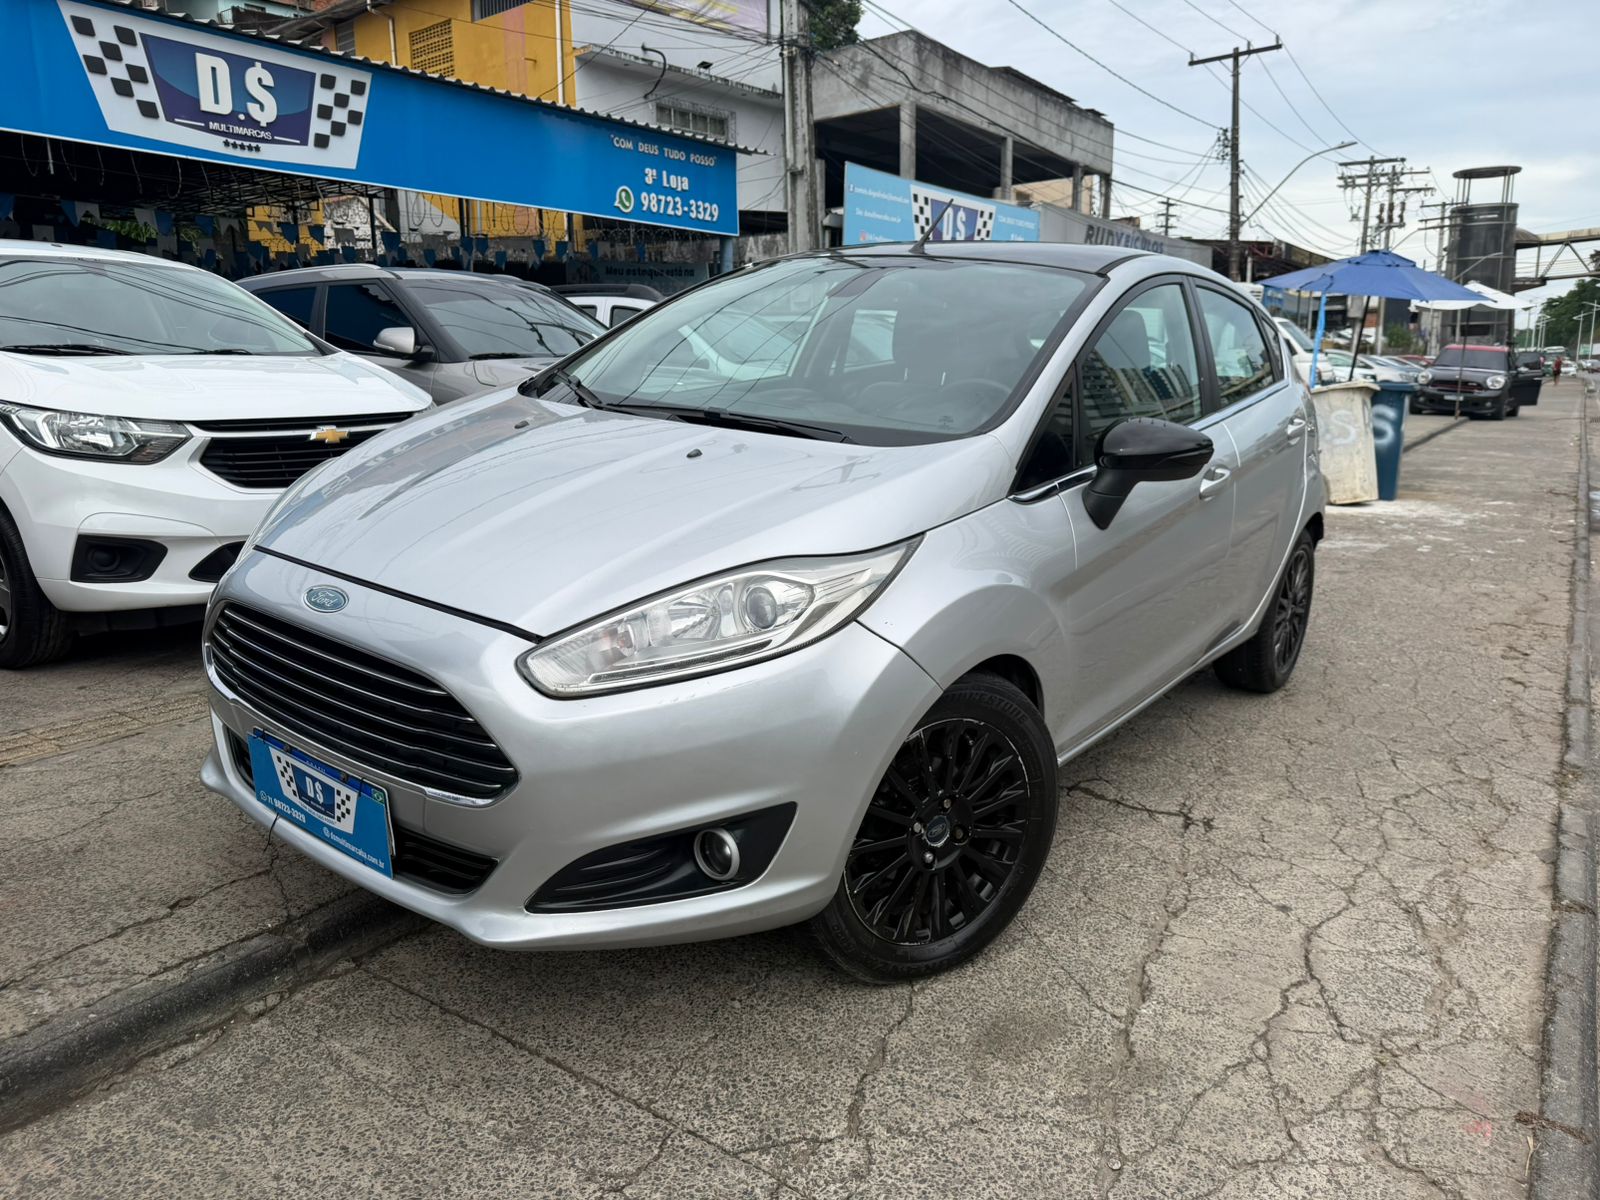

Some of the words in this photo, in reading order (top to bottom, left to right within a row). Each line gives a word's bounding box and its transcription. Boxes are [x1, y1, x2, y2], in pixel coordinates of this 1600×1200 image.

[208, 121, 273, 141] MULTIMARCAS
[638, 141, 659, 156] DEUS
[663, 147, 686, 161] TUDO
[662, 170, 689, 192] Loja
[640, 191, 719, 222] 98723-3329
[311, 590, 338, 607] Ford
